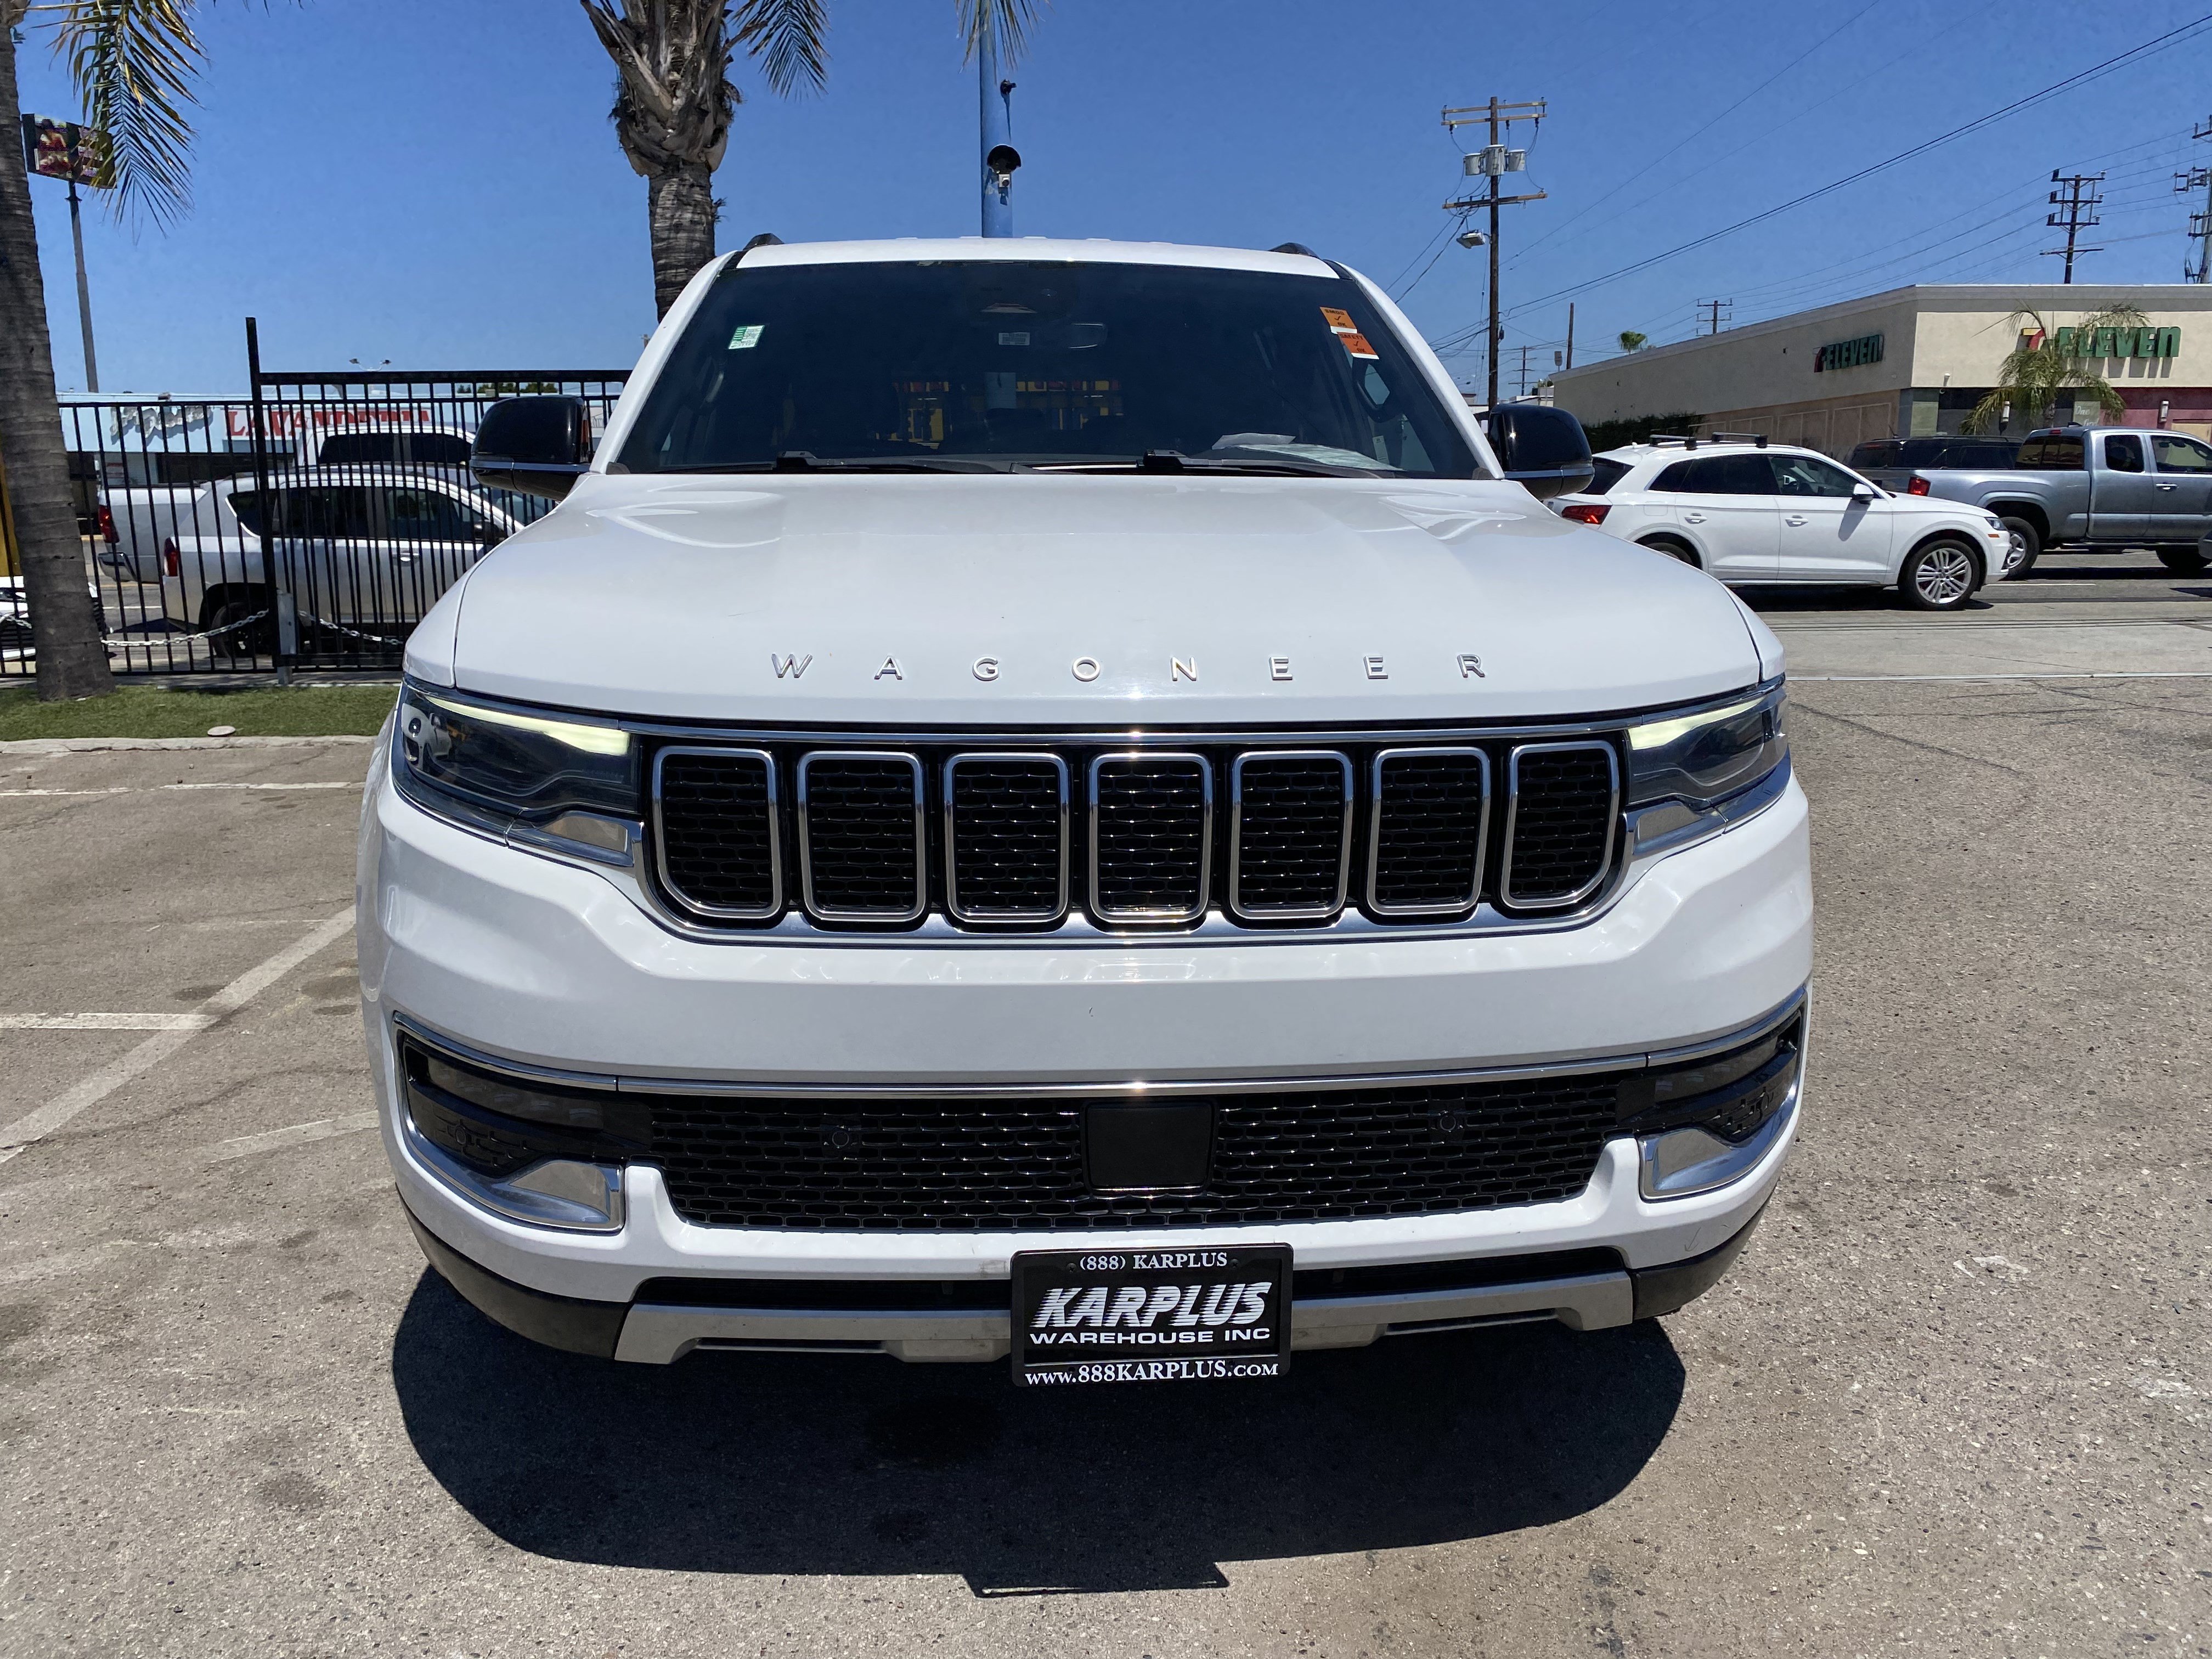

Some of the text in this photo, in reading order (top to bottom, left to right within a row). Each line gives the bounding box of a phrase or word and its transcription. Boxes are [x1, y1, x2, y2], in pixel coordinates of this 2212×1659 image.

[771, 653, 1486, 681] WAGONEER
[1080, 1252, 1227, 1271] (888) KARPLUS
[1029, 1282, 1272, 1328] KARPLUS
[1029, 1328, 1270, 1345] WAREHOUSE INC
